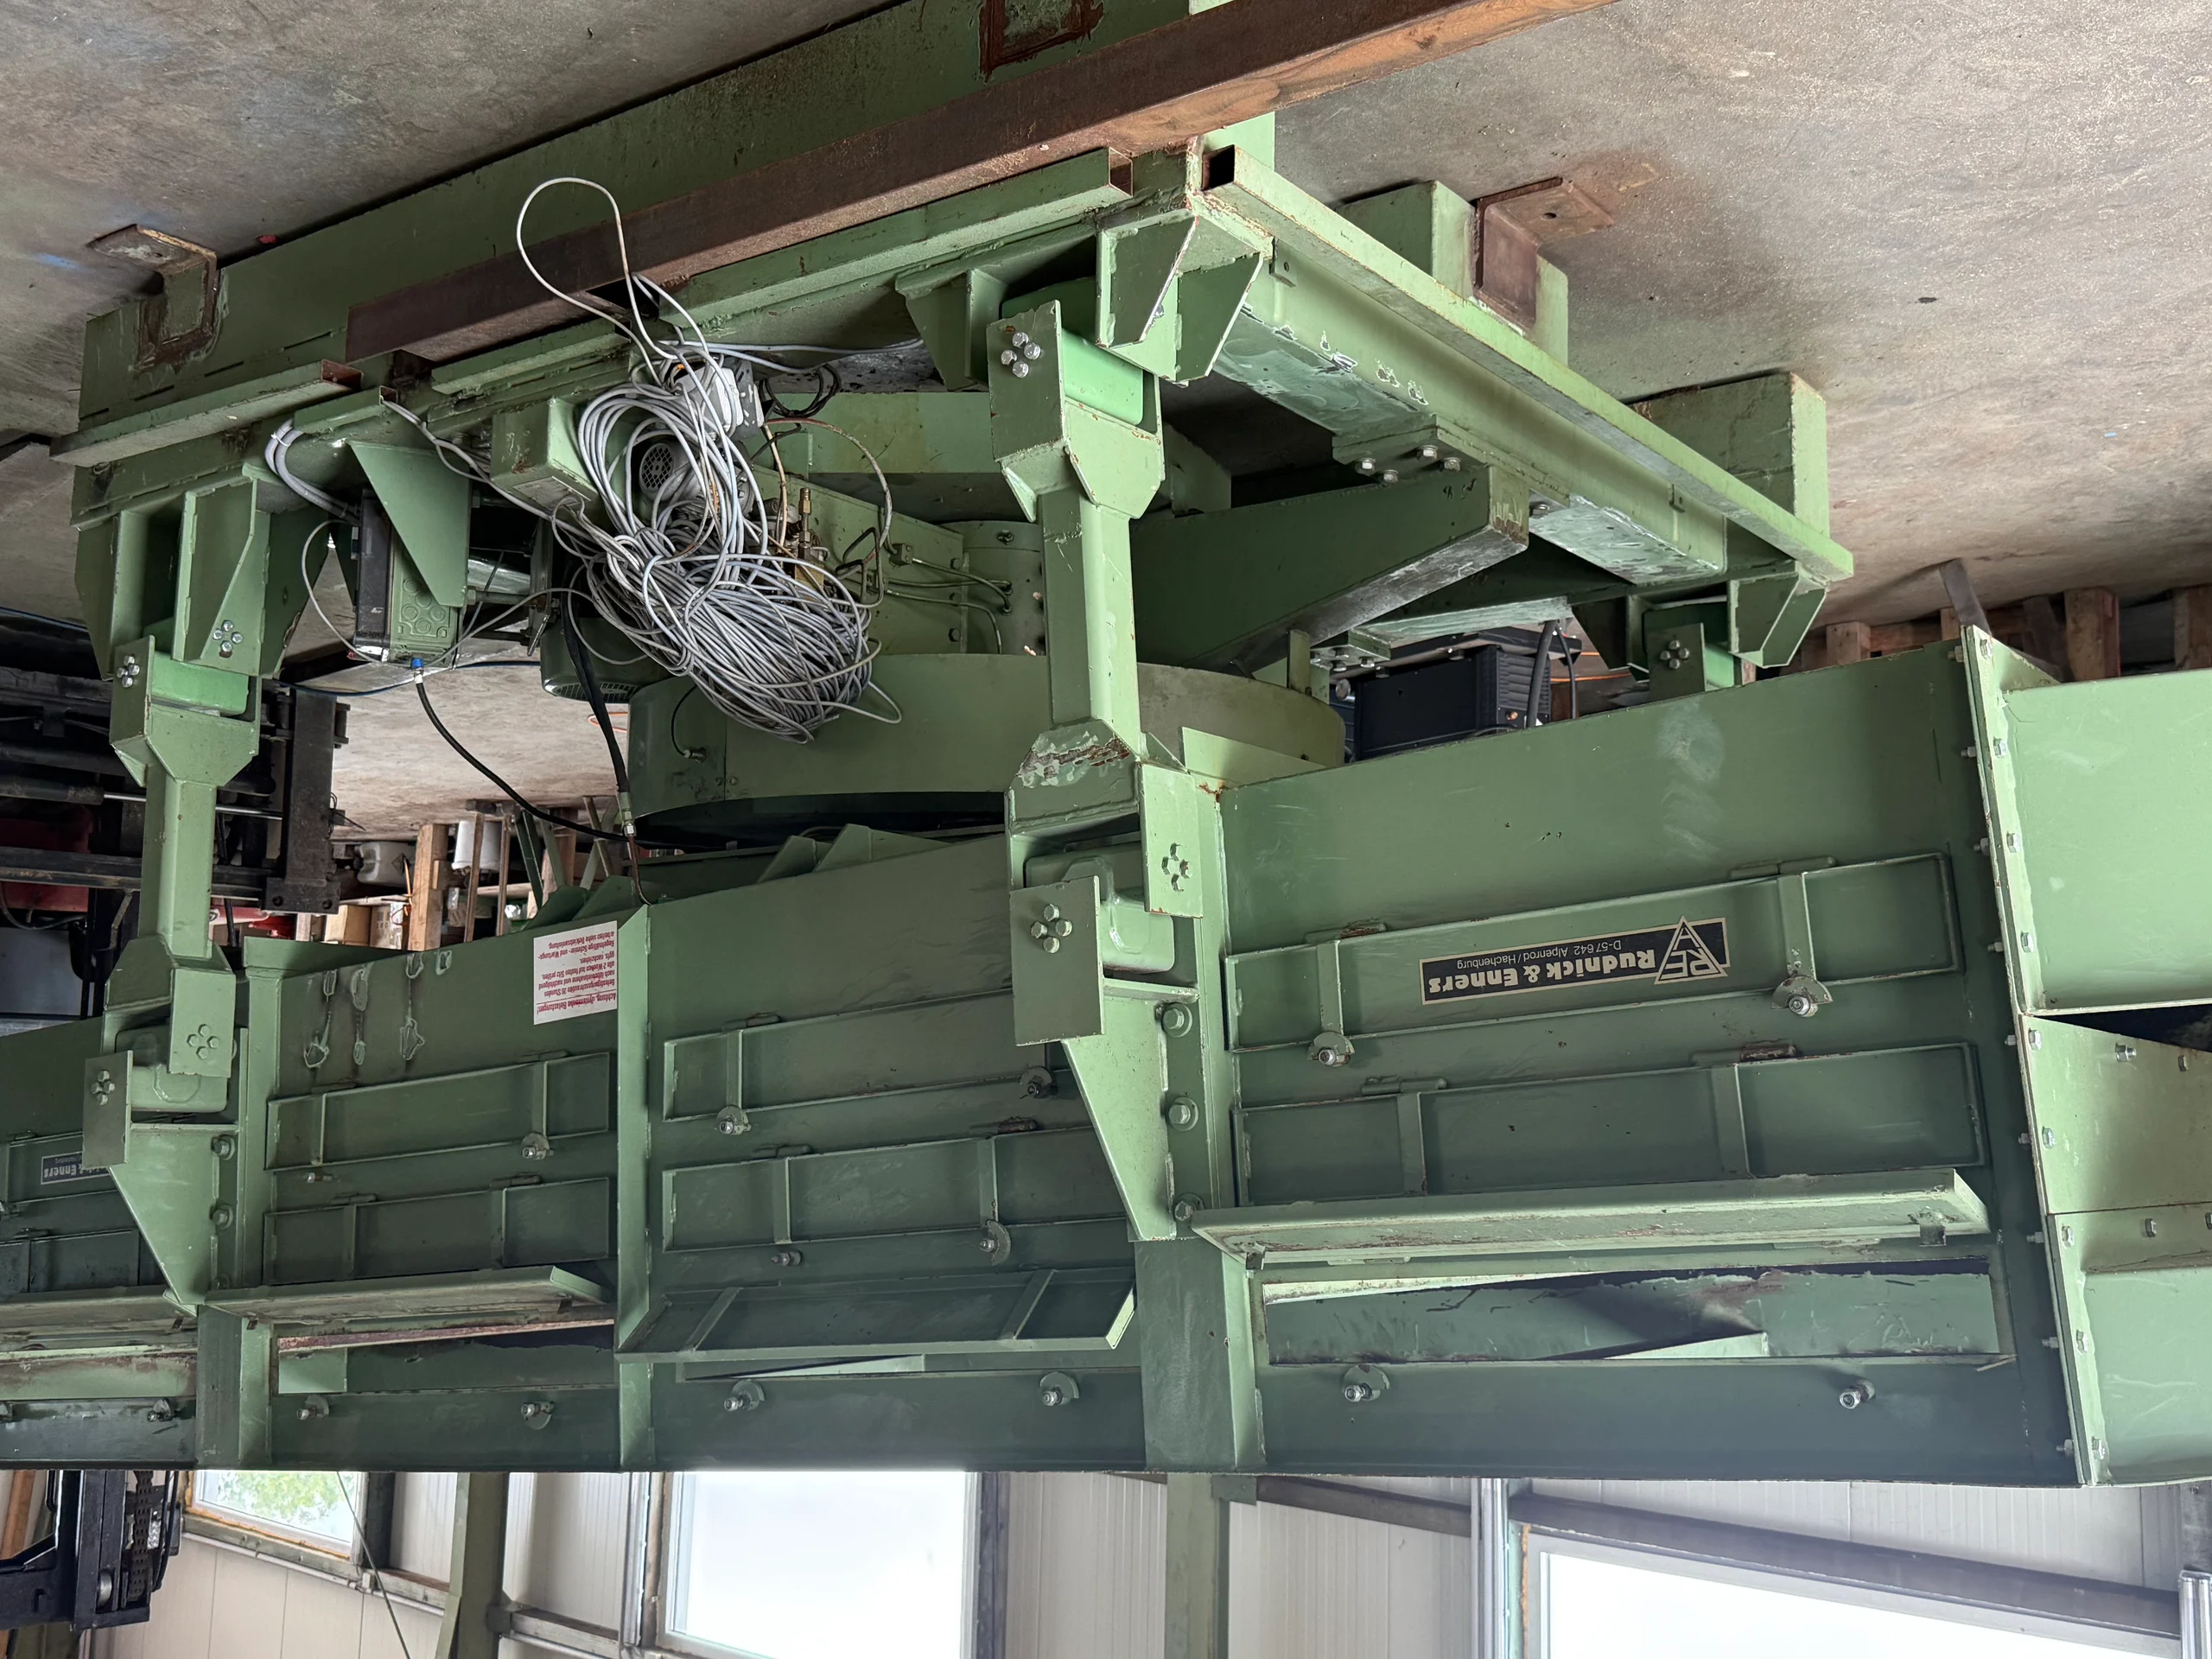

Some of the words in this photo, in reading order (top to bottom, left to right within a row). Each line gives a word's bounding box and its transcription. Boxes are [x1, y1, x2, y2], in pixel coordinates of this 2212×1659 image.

[1457, 954, 1516, 969] Hachenburg
[1523, 946, 1568, 962] Alpenrod
[1547, 949, 1656, 980] Rudnick
[563, 977, 571, 986] und
[1428, 968, 1518, 994] Enners
[1523, 966, 1539, 983] &
[544, 988, 562, 997] Stunden
[537, 1001, 567, 1014] Belastungen!
[44, 1164, 76, 1178] Enners
